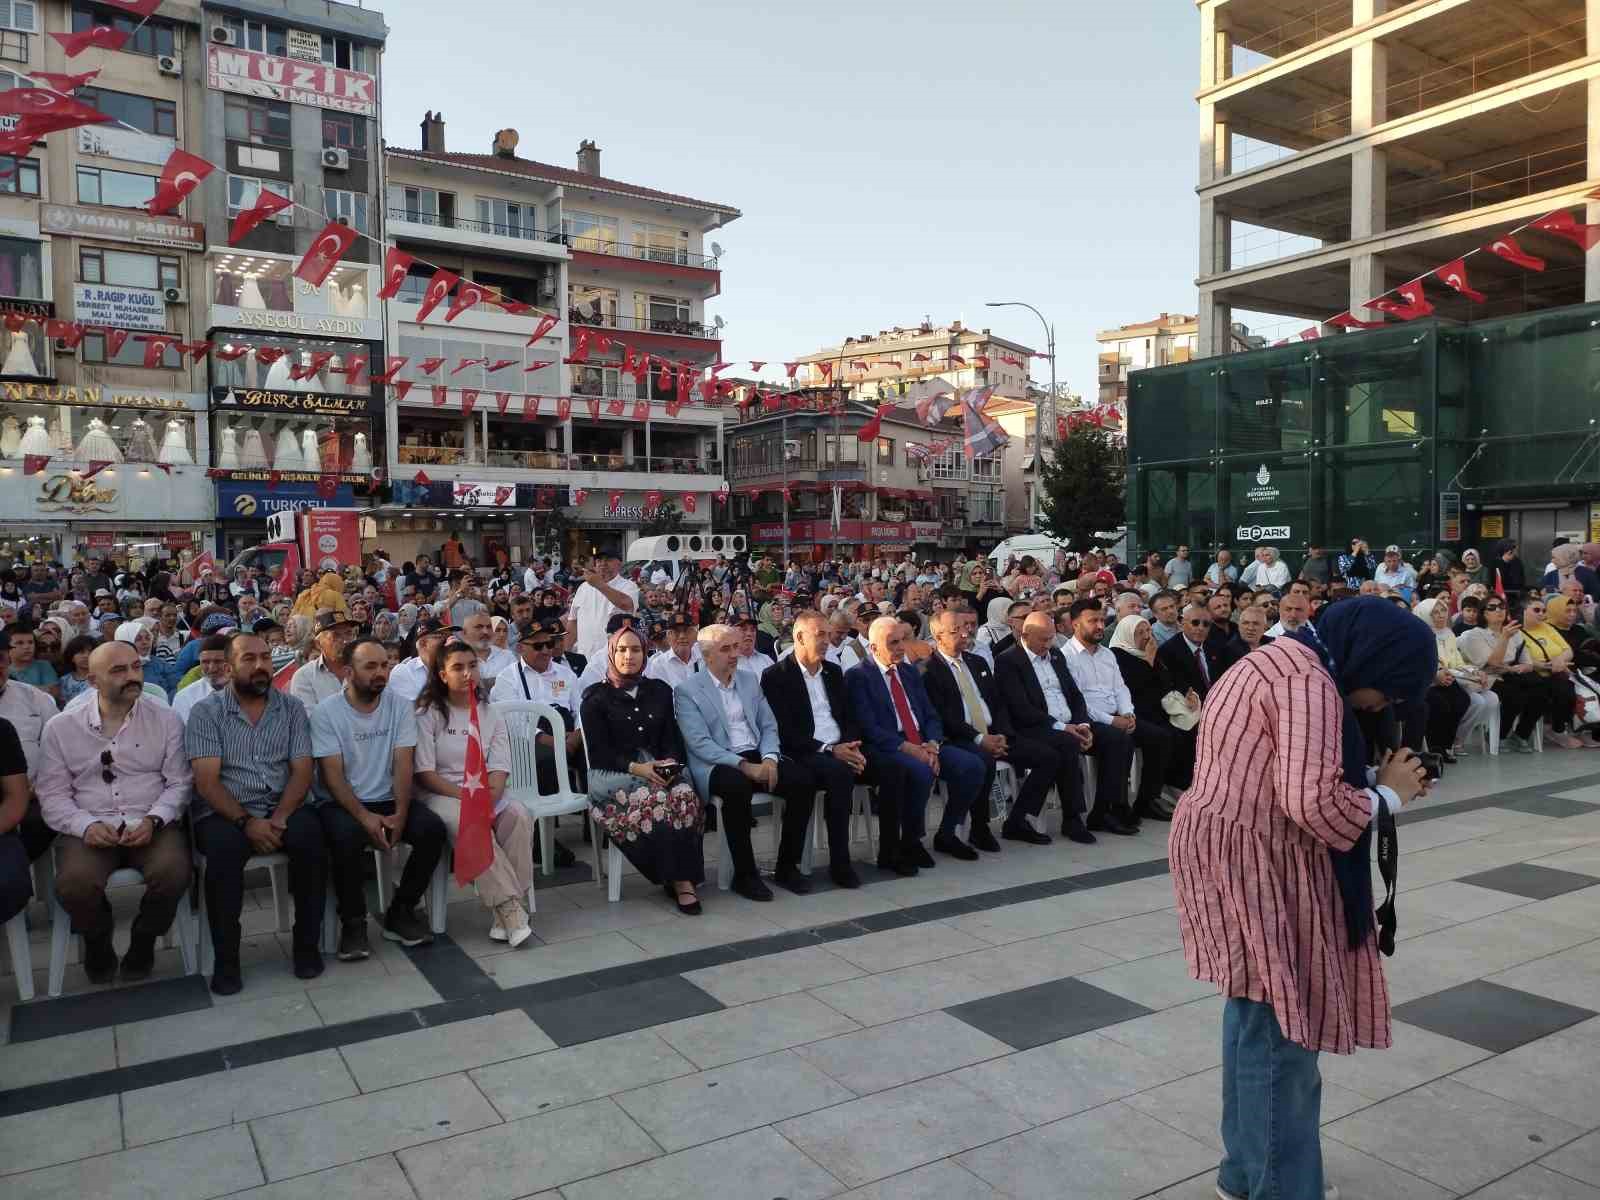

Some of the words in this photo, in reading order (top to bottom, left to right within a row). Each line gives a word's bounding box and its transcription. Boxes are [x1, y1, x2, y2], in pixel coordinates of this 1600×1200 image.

[216, 50, 373, 101] MÜZİK
[75, 213, 131, 231] VATAN
[128, 293, 155, 306] KUĞU
[315, 319, 364, 335] AYDIN
[243, 390, 299, 409] BÜŞRA
[302, 393, 367, 410] SALMAN
